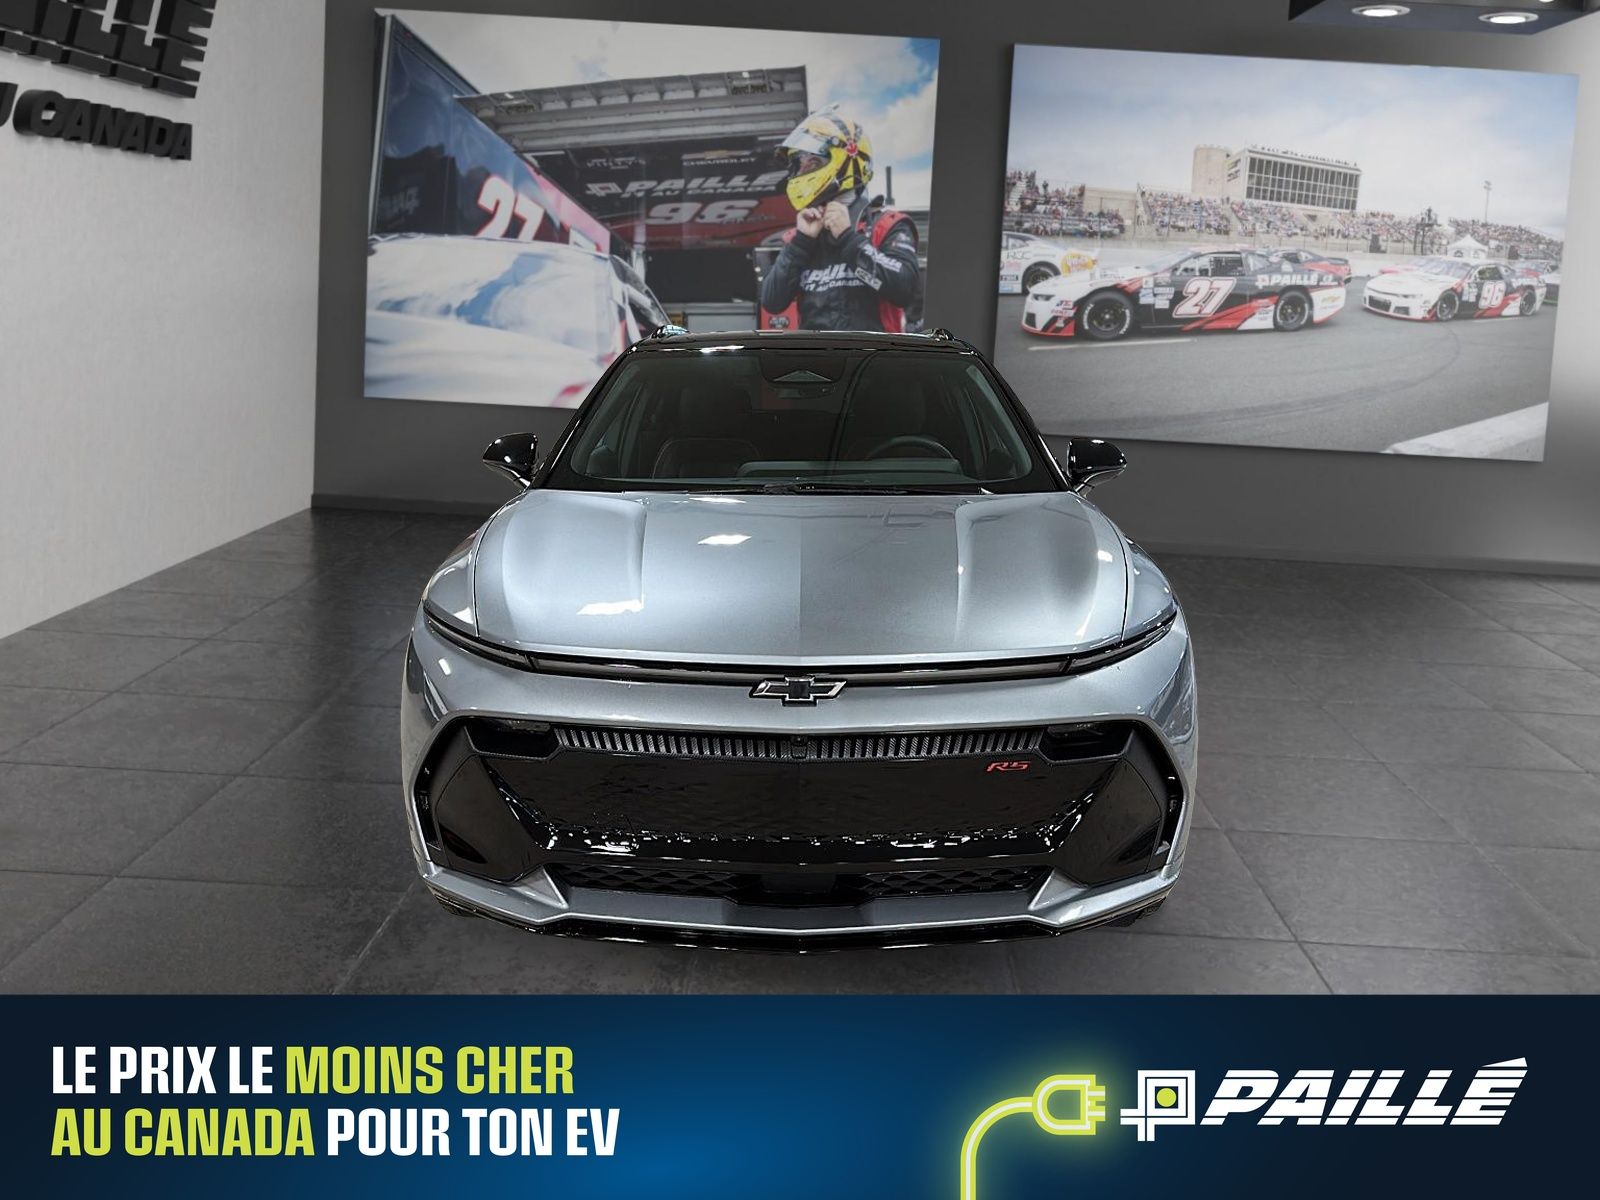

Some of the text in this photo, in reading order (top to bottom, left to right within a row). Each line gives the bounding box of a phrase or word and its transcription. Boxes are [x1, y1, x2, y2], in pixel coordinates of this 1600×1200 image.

[13, 89, 193, 161] CANADA
[475, 173, 545, 243] 27
[645, 199, 760, 225] 96
[1172, 277, 1237, 318] 27
[986, 760, 1031, 772] RS
